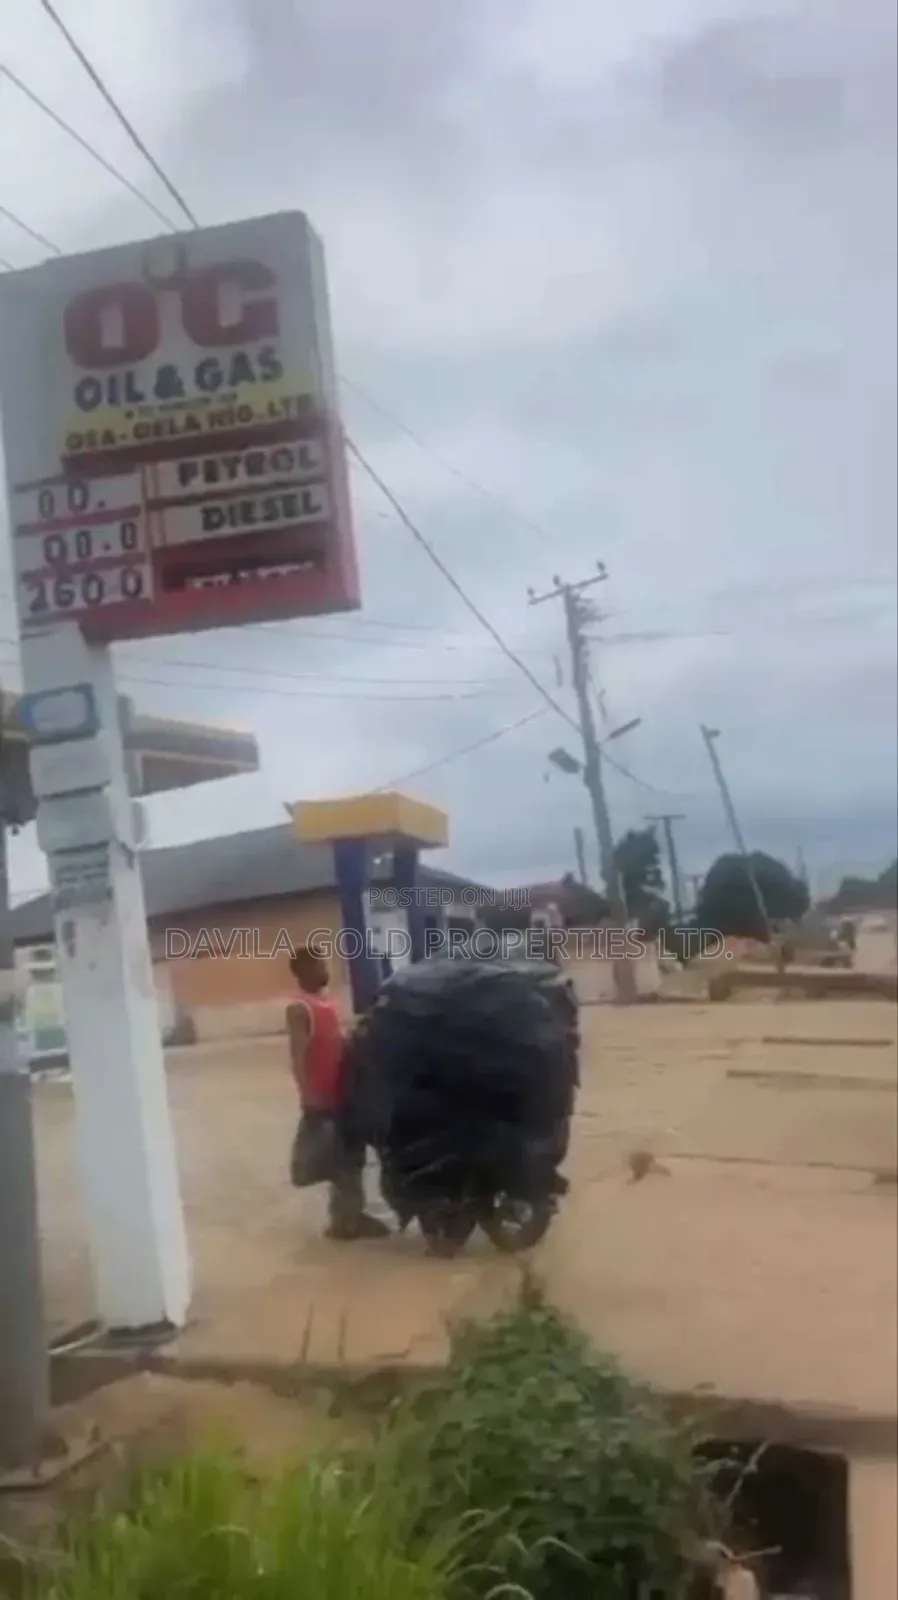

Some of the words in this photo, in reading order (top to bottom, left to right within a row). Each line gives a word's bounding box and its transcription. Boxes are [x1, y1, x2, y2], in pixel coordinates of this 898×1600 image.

[74, 370, 146, 412] OIL
[154, 364, 185, 399] &
[194, 348, 284, 392] GAS
[176, 448, 319, 487] PETROL
[201, 491, 323, 532] DIESEL
